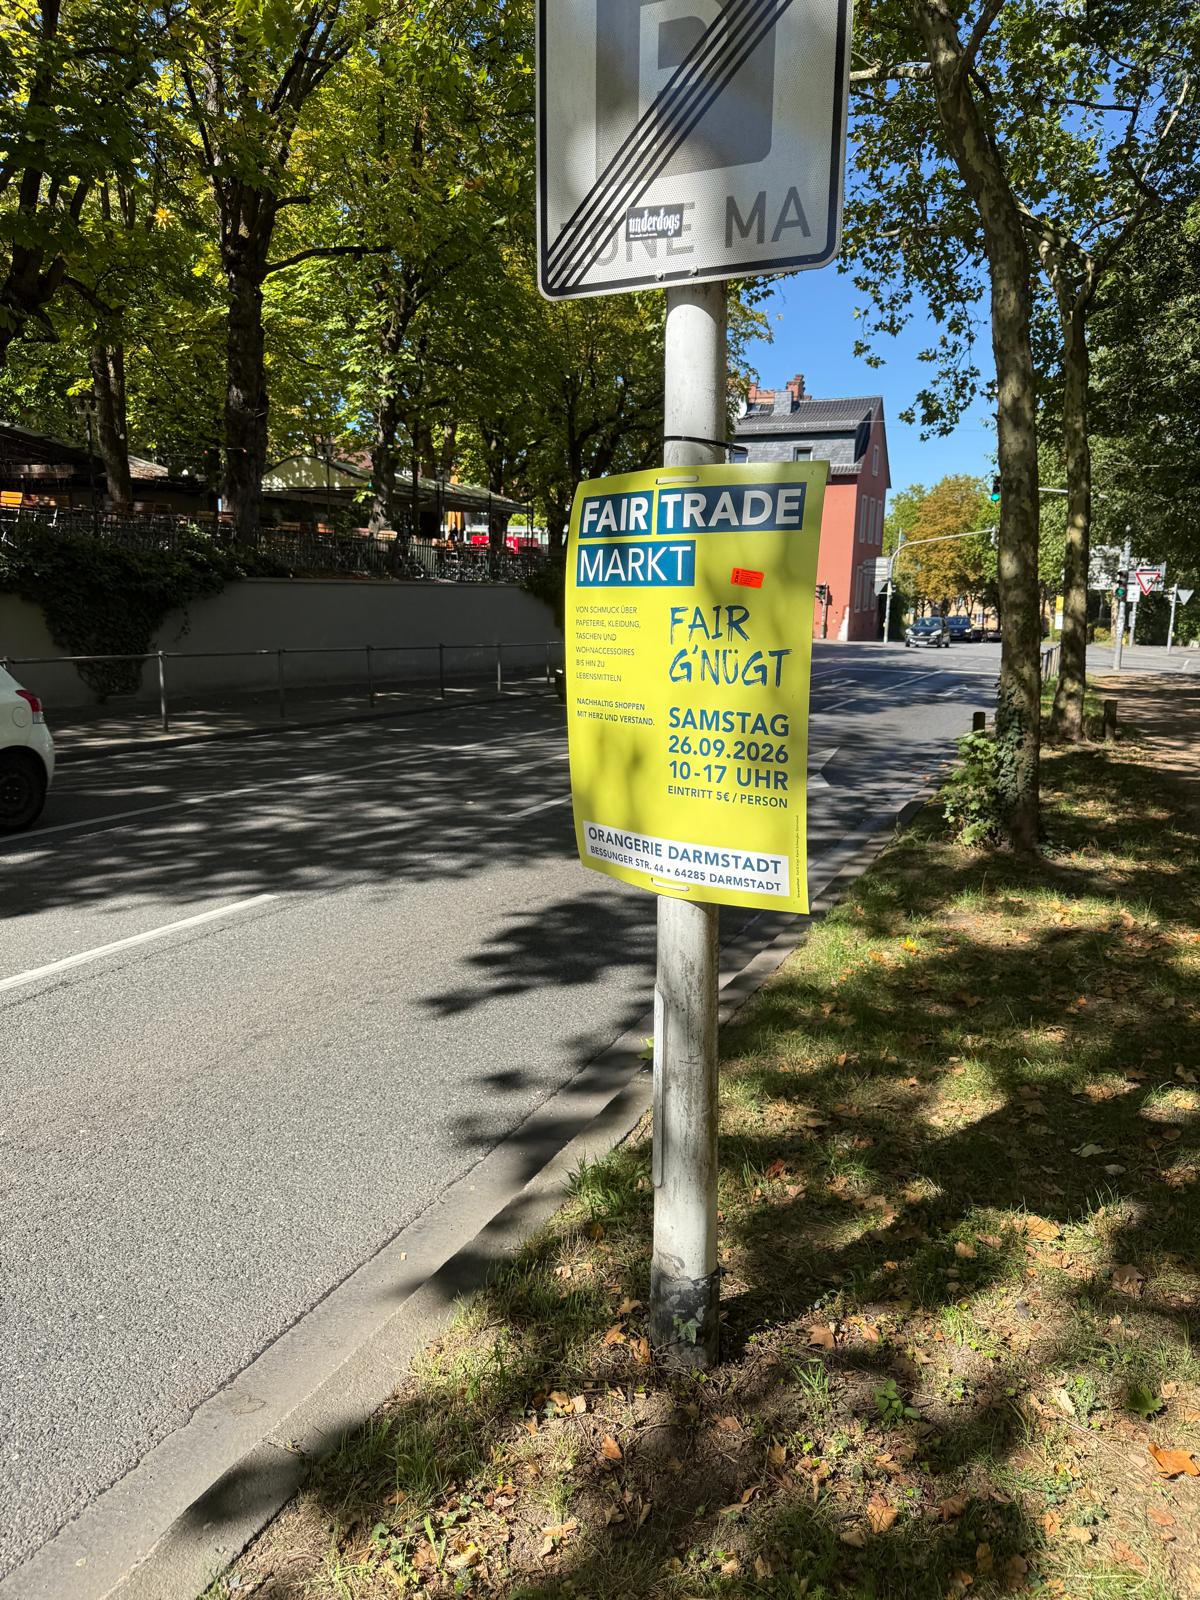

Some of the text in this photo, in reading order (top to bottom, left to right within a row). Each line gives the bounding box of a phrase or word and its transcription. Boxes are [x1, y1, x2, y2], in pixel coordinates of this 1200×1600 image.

[628, 207, 681, 237] underdogs
[725, 187, 811, 249] MA
[582, 488, 802, 533] FAIR TRADE
[579, 546, 691, 582] MARKT
[576, 604, 637, 614] VON SCHMUCK ÜBER
[576, 619, 641, 629] PAPETERIE, KLEIDUNG,
[669, 605, 750, 645] FAIR
[576, 632, 617, 641] TASCHEN UND
[576, 646, 635, 656] WOHNACCESSOIRES
[597, 660, 605, 668] ZU
[576, 672, 622, 682] LEBENSMITTELN
[576, 697, 645, 711] NACHHALTIG SHOPPEN
[576, 710, 655, 726] MIT HERZ UND VERSTAND.
[669, 706, 789, 737] SAMSTAG
[669, 735, 789, 764] 26.09.2026
[737, 767, 789, 791] UHR
[668, 785, 713, 800] EINTRITT
[716, 791, 730, 802] 5€
[740, 794, 788, 809] PERSON
[588, 826, 781, 874] ORANGERIE DARMSTADT
[590, 845, 782, 892] BESSUNGER STR. 44 64285 DARMSTADT
